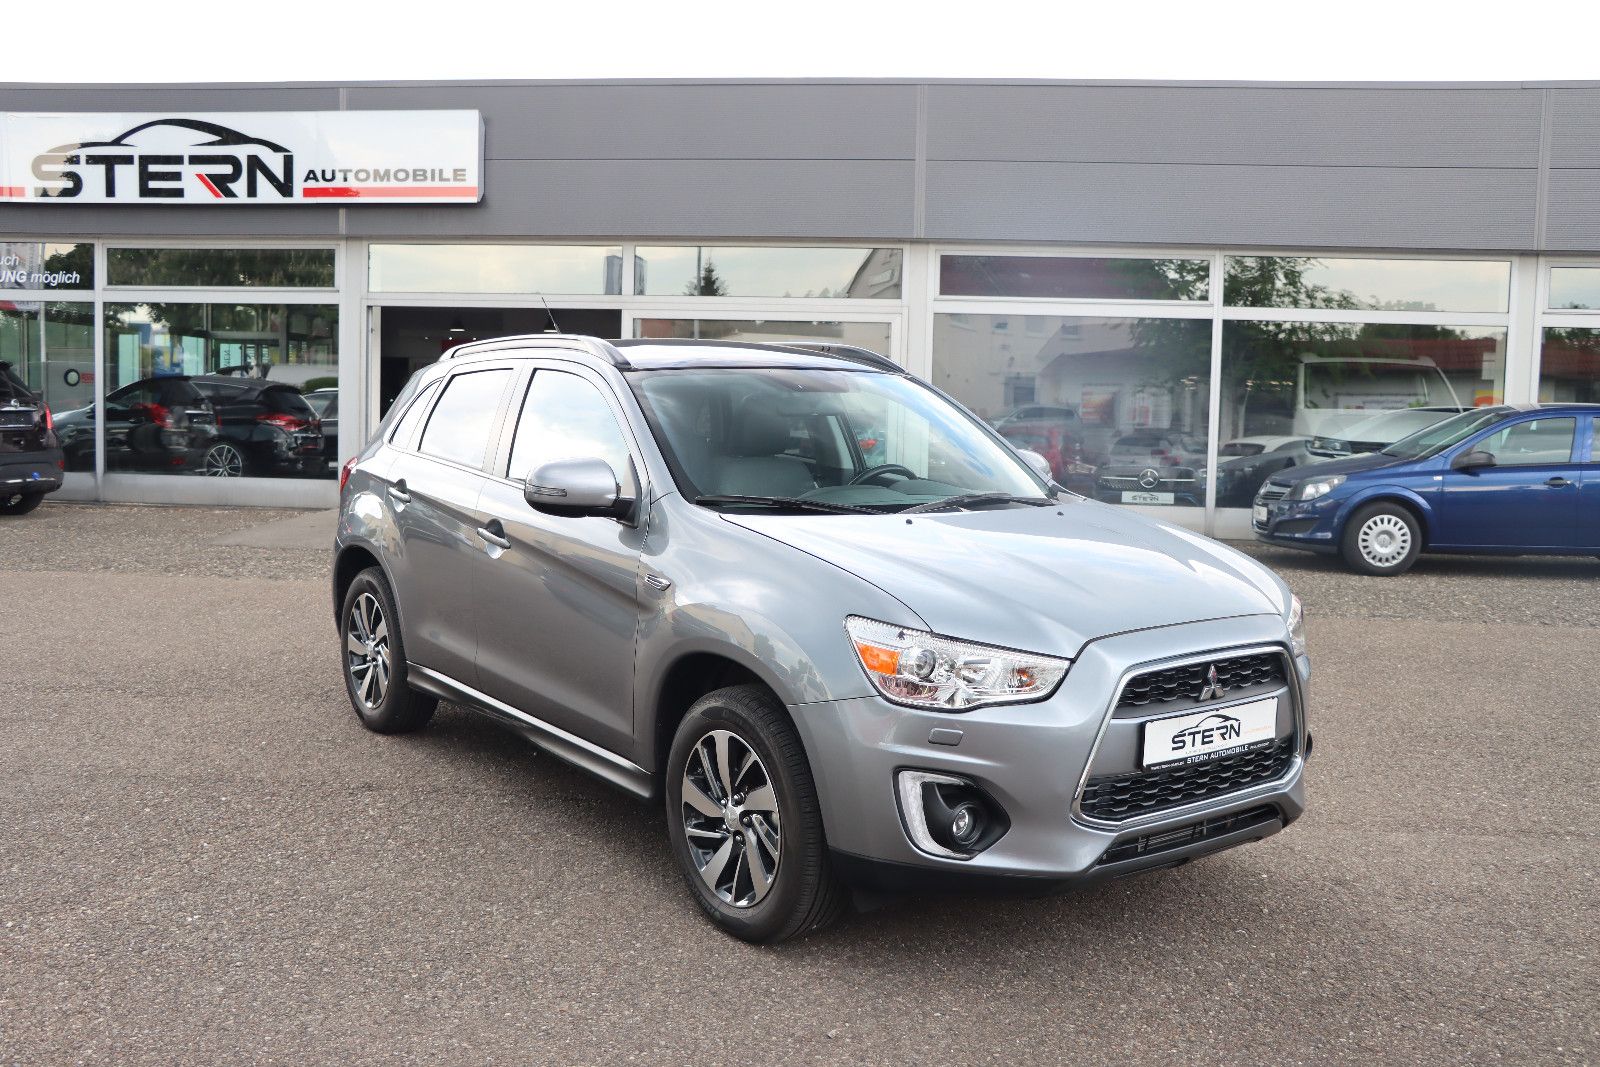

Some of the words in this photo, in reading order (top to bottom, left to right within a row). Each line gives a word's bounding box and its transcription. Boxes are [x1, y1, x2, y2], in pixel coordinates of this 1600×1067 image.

[31, 154, 294, 198] STERN
[303, 168, 467, 183] AUTOMOBILE
[31, 271, 80, 286] möglich
[1171, 721, 1241, 751] STERN
[1186, 752, 1209, 764] STERN
[1210, 744, 1249, 759] AUTOMOBILE
